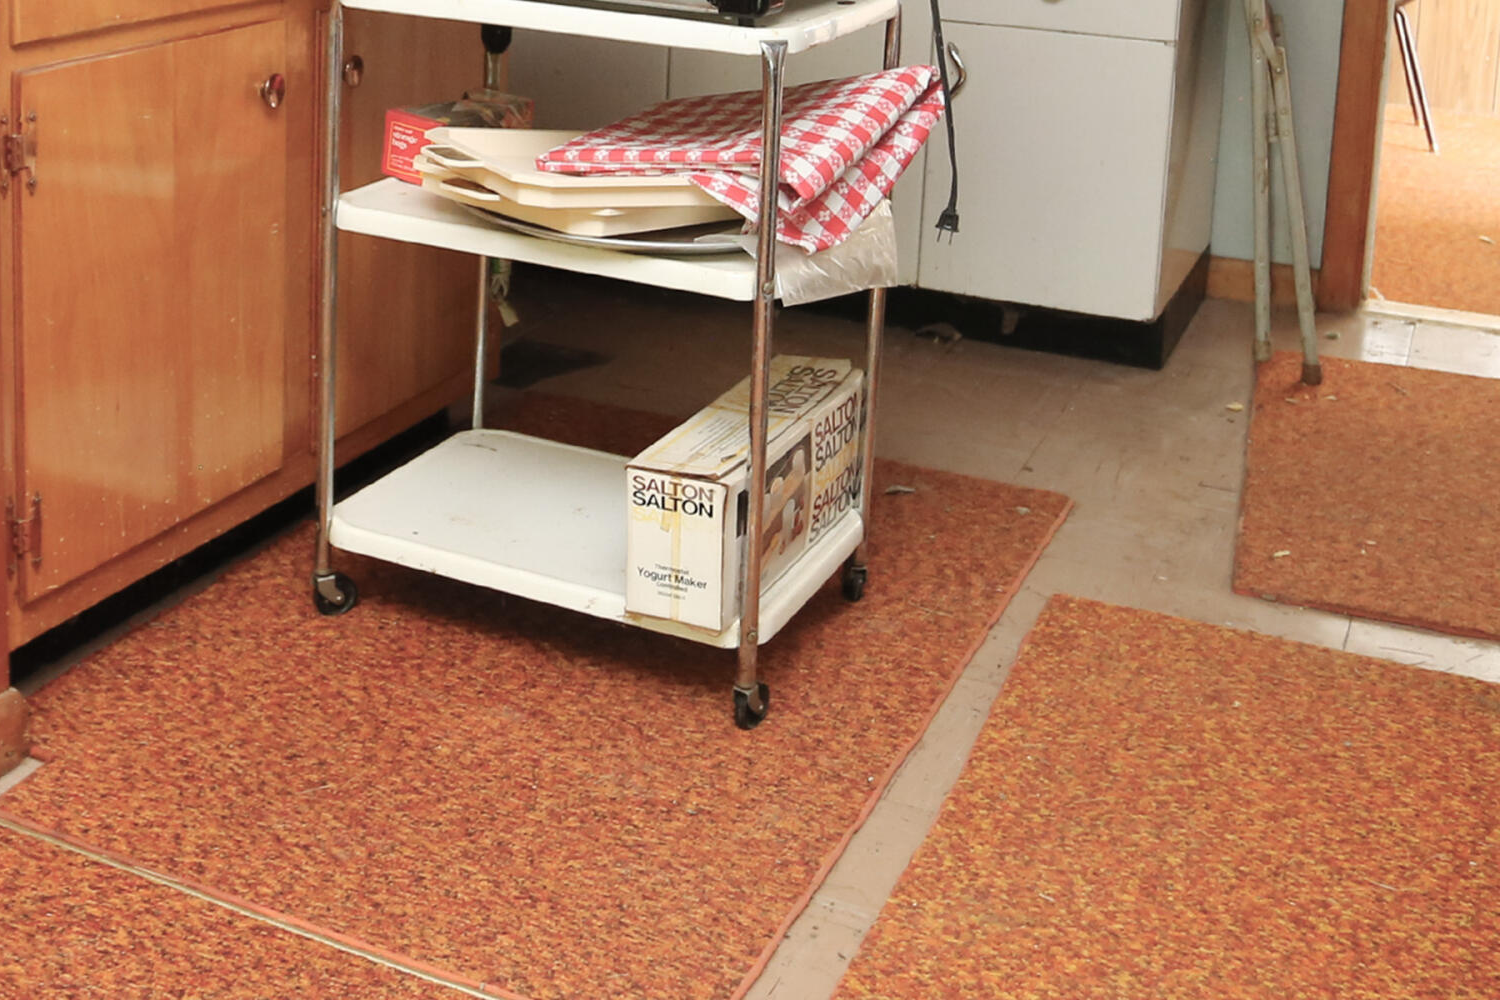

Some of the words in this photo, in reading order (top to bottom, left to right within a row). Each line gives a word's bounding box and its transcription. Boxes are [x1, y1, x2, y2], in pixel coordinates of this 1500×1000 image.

[632, 475, 714, 503] SALTON
[632, 490, 714, 518] SALTON
[637, 566, 672, 582] Yogurt
[674, 574, 707, 589] Maker
